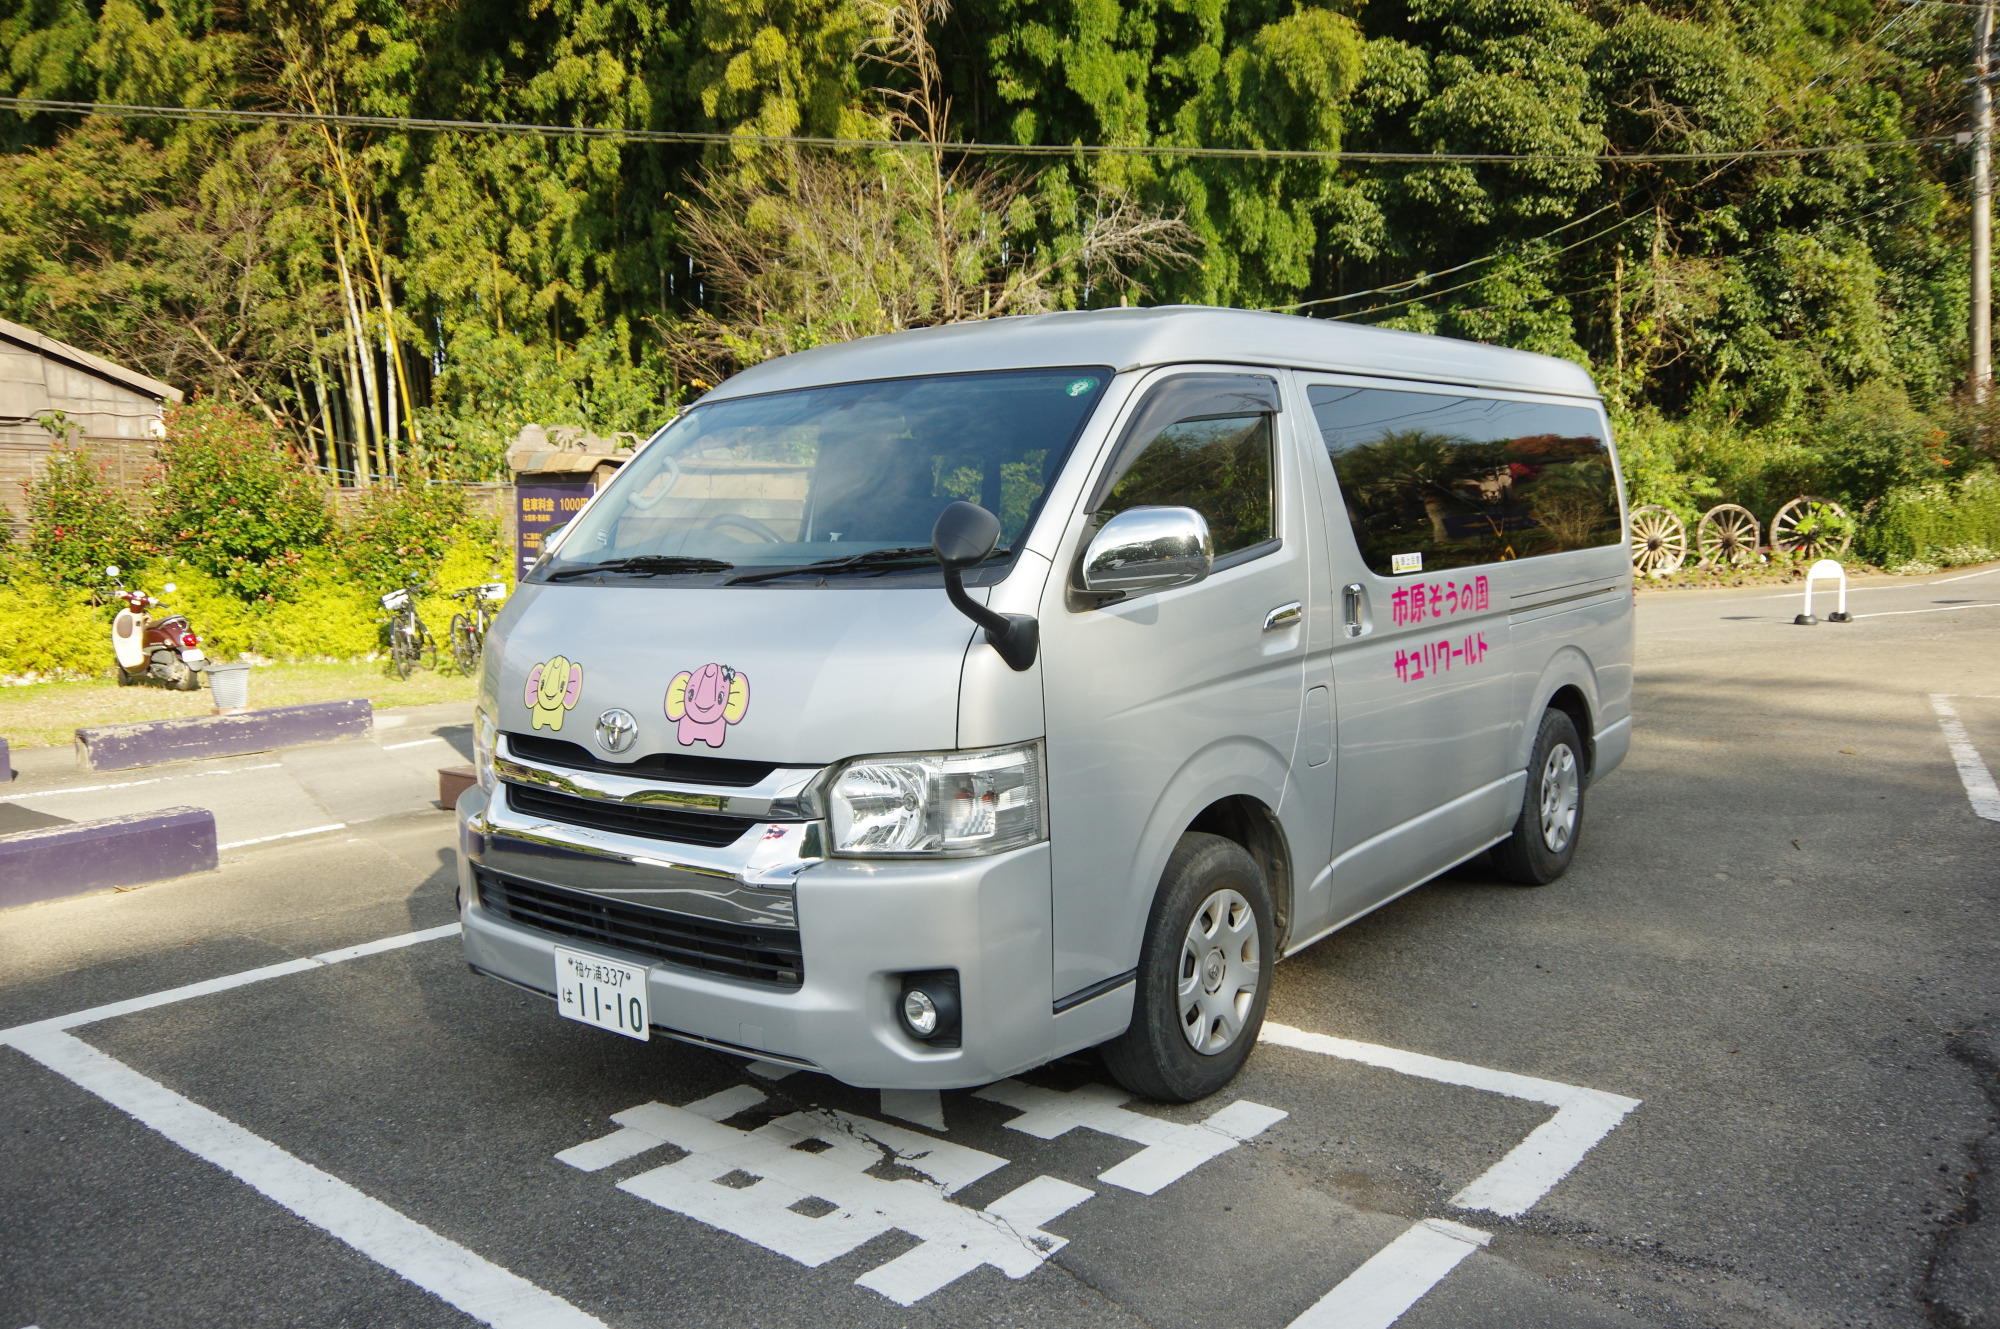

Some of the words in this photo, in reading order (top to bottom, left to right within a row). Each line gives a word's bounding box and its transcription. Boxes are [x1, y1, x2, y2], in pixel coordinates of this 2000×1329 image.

[522, 497, 555, 512] 駐車料金
[1391, 575, 1489, 627] 市原ぞうの国
[1394, 631, 1488, 683] サユリワールド
[562, 987, 573, 1004] は
[579, 982, 643, 1033] 11-10
